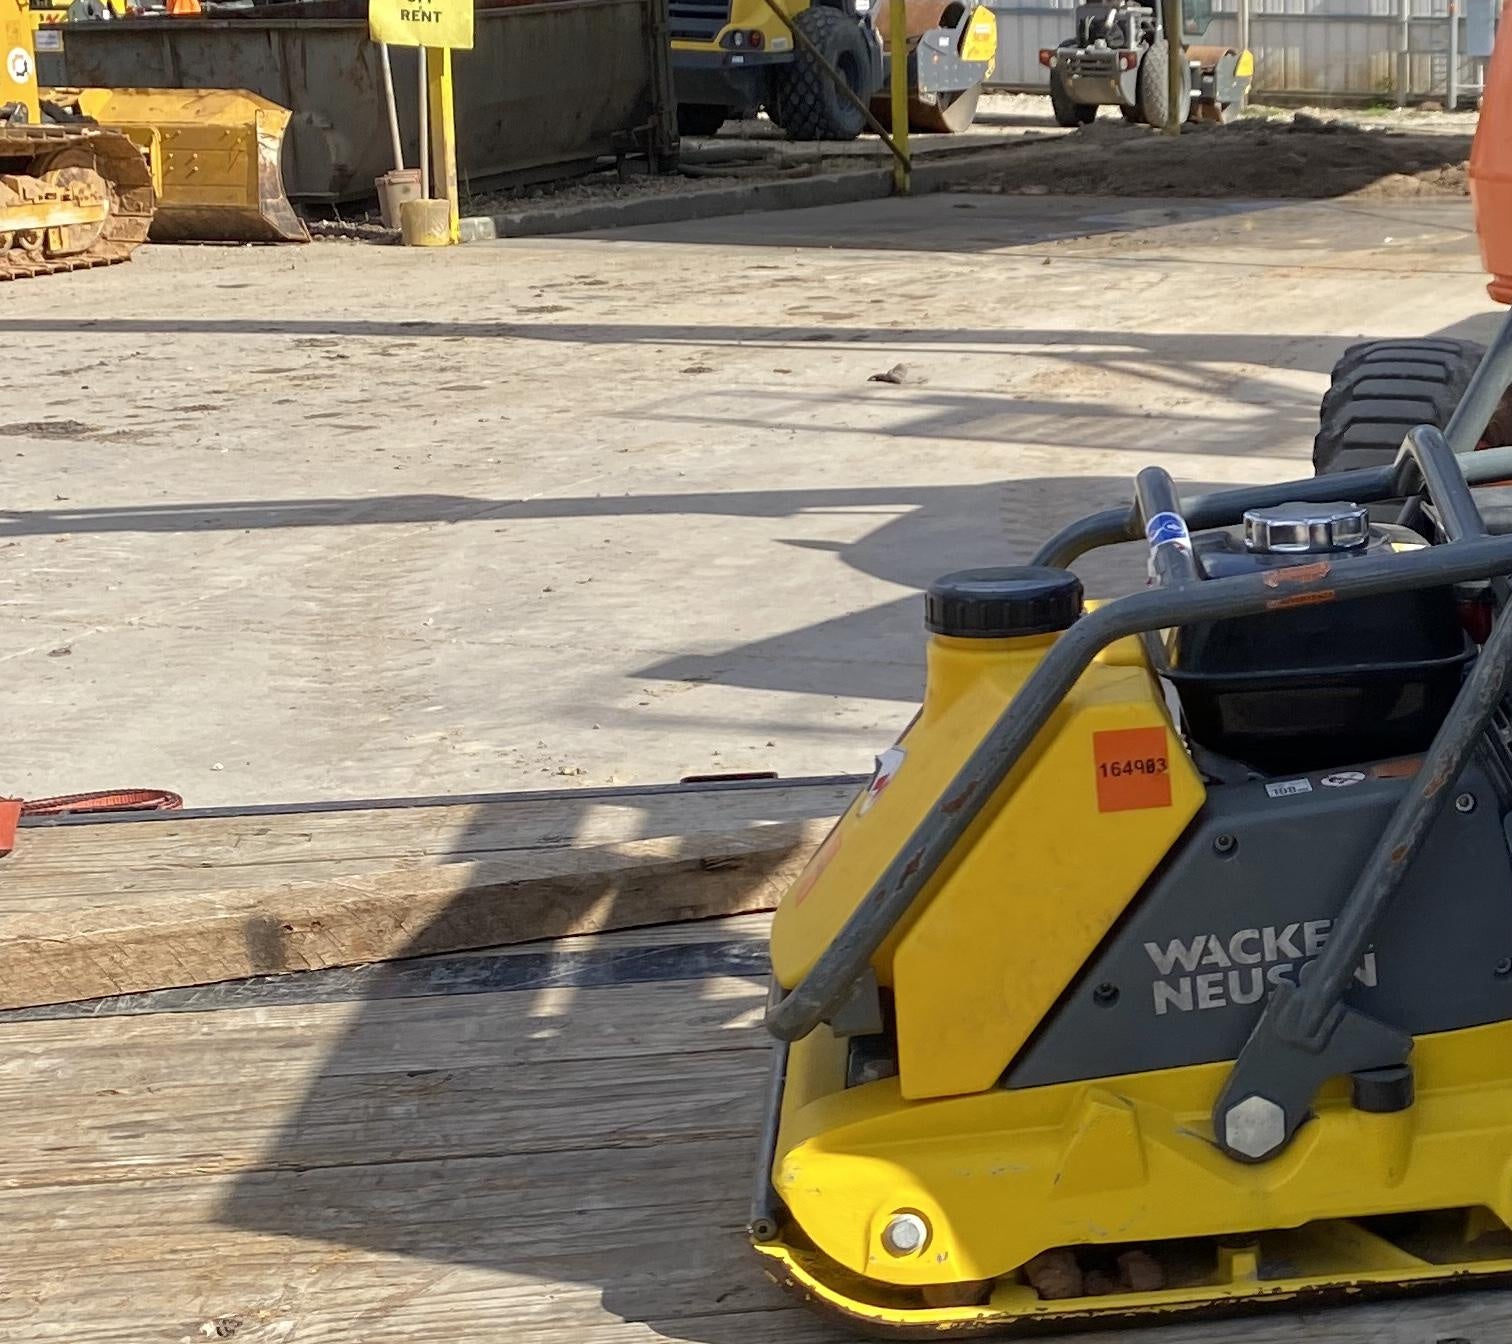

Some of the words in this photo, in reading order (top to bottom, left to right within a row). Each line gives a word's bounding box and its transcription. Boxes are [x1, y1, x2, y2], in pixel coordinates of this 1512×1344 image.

[400, 8, 443, 24] RENT
[1099, 757, 1168, 778] 164903
[1143, 919, 1339, 976] WACKE
